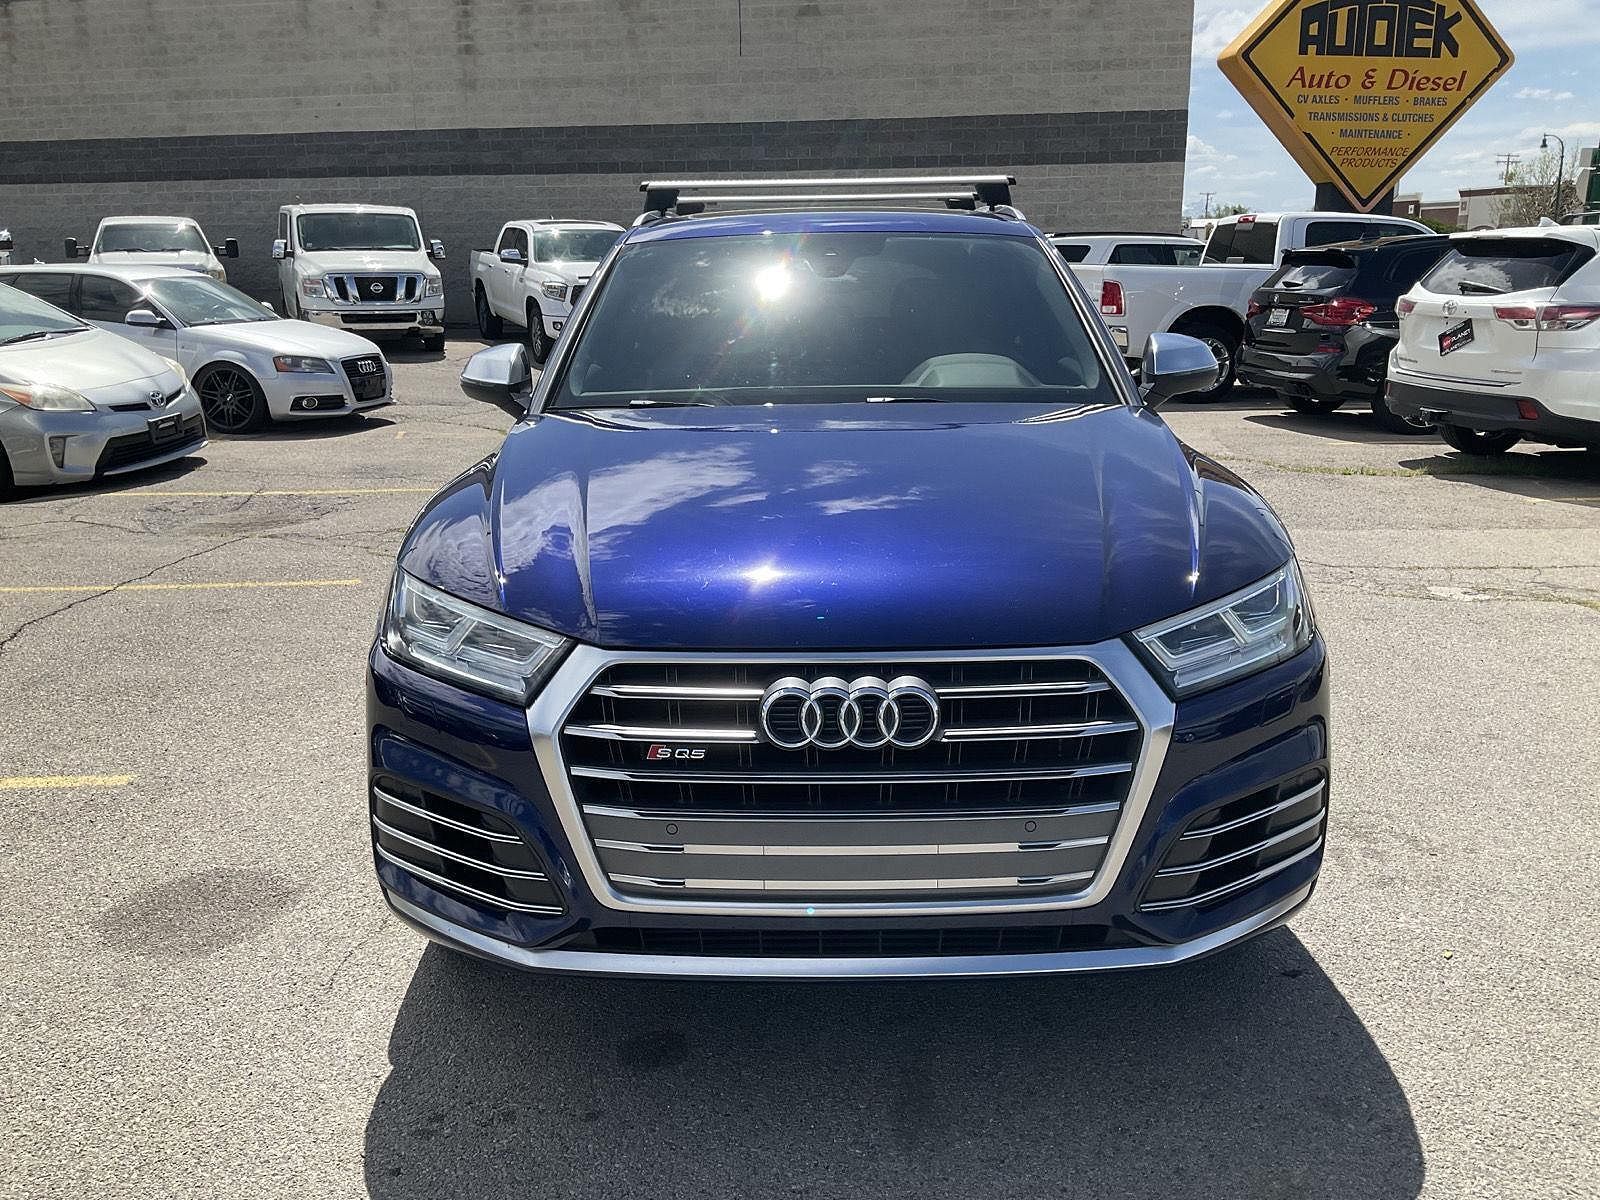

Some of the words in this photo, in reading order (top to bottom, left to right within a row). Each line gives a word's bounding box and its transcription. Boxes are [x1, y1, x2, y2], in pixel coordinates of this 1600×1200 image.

[1286, 66, 1352, 90] Auto
[1360, 68, 1378, 89] &
[1386, 68, 1468, 92] Diesel
[1296, 94, 1310, 104] CV
[1311, 94, 1340, 105] AXLES
[1353, 95, 1400, 106] MUFFLERS
[1413, 96, 1448, 107] BRAKES
[1308, 111, 1380, 123] TRANSMISSIONS
[1382, 113, 1389, 122] &
[1392, 113, 1435, 123] CLUTCHES
[1339, 128, 1403, 140] MAINTENANCE
[1329, 146, 1410, 157] PERFORMANCE
[1340, 158, 1398, 168] PRODUCTS
[650, 746, 706, 759] SQ5
